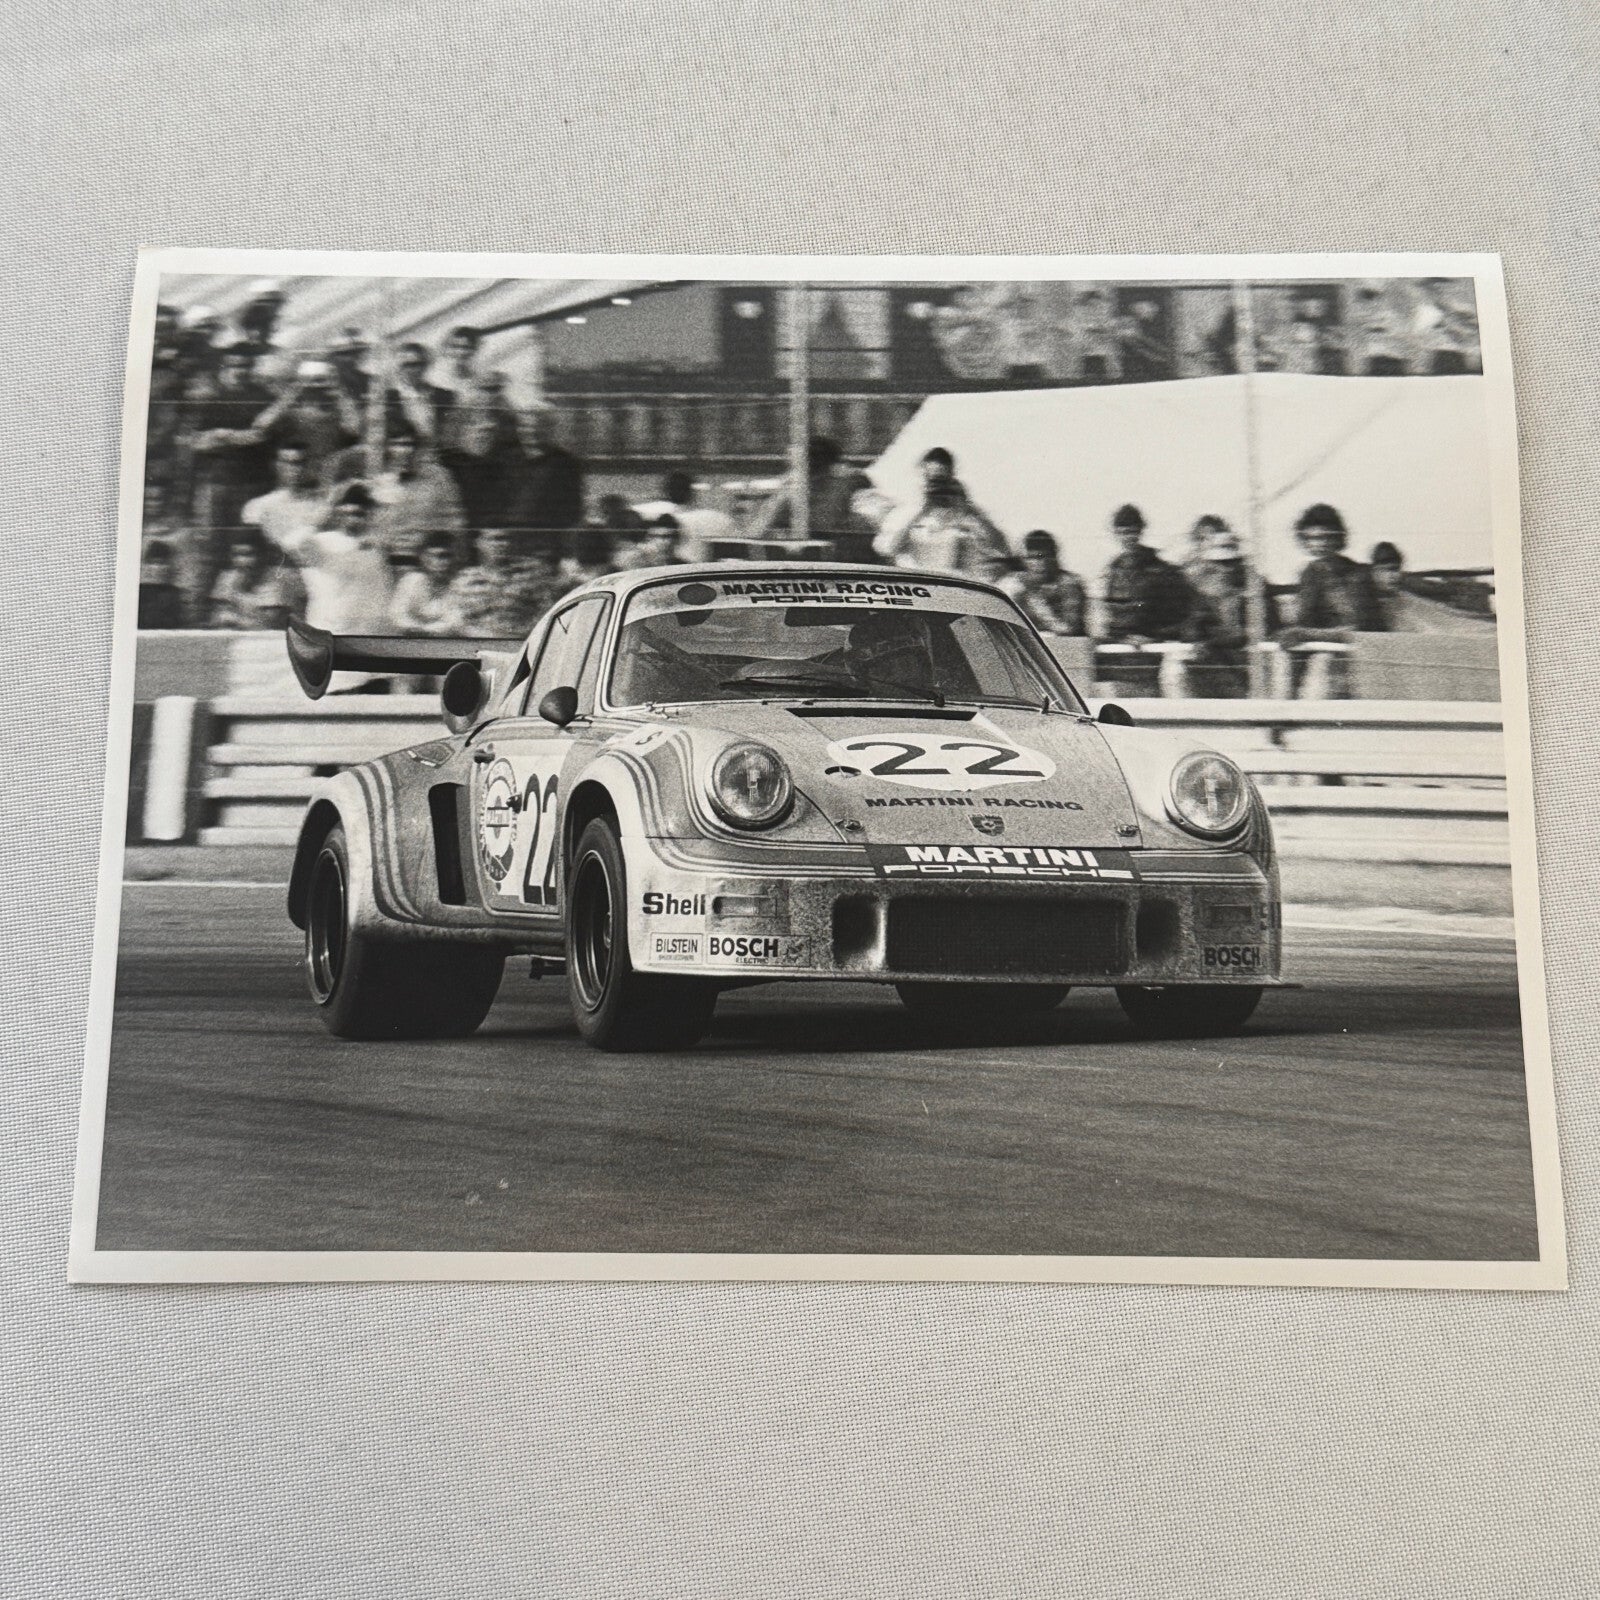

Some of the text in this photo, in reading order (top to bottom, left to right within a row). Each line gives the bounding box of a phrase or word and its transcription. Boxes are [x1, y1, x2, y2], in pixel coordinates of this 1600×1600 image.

[722, 582, 932, 598] MARTINI RACING
[750, 595, 914, 606] PORSCHE
[846, 741, 1045, 777] 22
[864, 797, 1084, 811] MARTINI RACING
[522, 773, 558, 905] 22
[904, 846, 1099, 868] MARTINI
[884, 865, 1135, 880] PORSCHE
[642, 892, 706, 916] Shell
[655, 938, 698, 953] BILSTEIN
[709, 937, 779, 957] BOSCH
[1204, 946, 1261, 967] BOSCH
